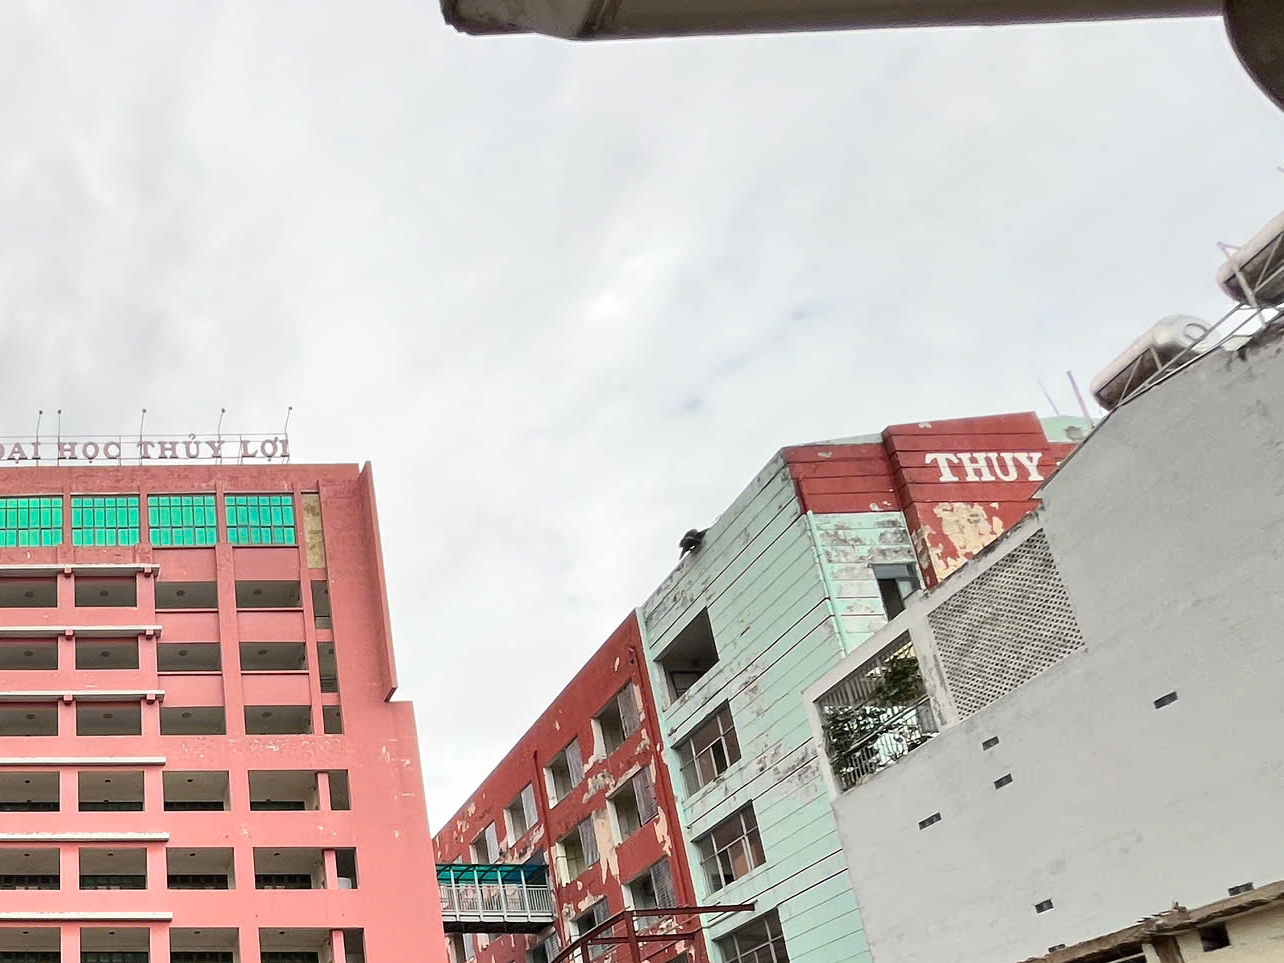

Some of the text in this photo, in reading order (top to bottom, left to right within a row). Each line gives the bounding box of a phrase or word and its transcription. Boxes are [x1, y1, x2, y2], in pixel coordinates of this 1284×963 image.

[57, 440, 122, 464] HỌC
[137, 433, 225, 460] THỦY
[241, 436, 289, 462] LỢI
[924, 452, 1045, 482] THUY
